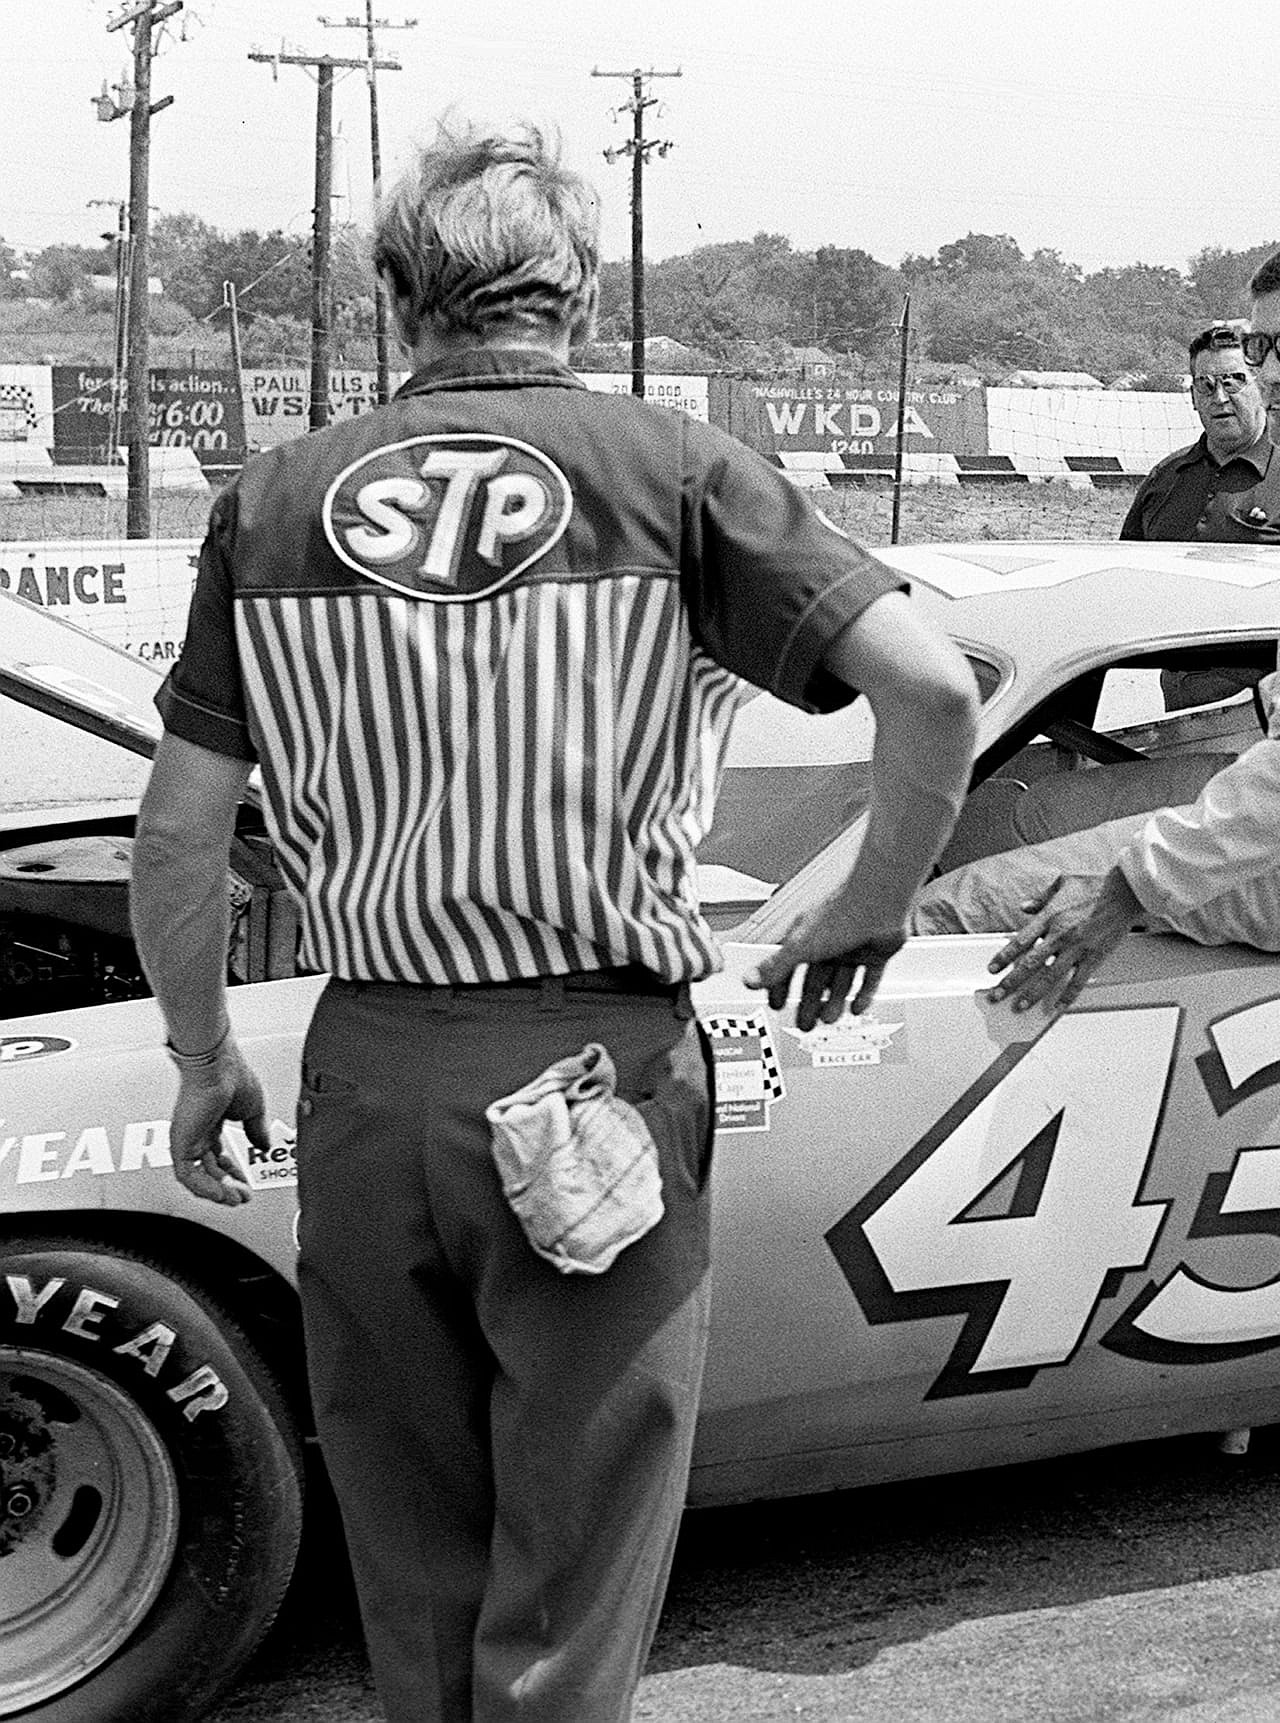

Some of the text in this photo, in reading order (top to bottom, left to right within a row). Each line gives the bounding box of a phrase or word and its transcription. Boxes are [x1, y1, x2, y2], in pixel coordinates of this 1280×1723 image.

[254, 376, 305, 393] PAUL
[331, 376, 363, 393] LLS
[877, 389, 924, 404] COUTRY
[166, 400, 224, 427] 6:00
[765, 401, 934, 439] WKDA
[830, 439, 874, 454] 1240
[345, 447, 551, 587] STP
[5, 1274, 230, 1422] YEAR
